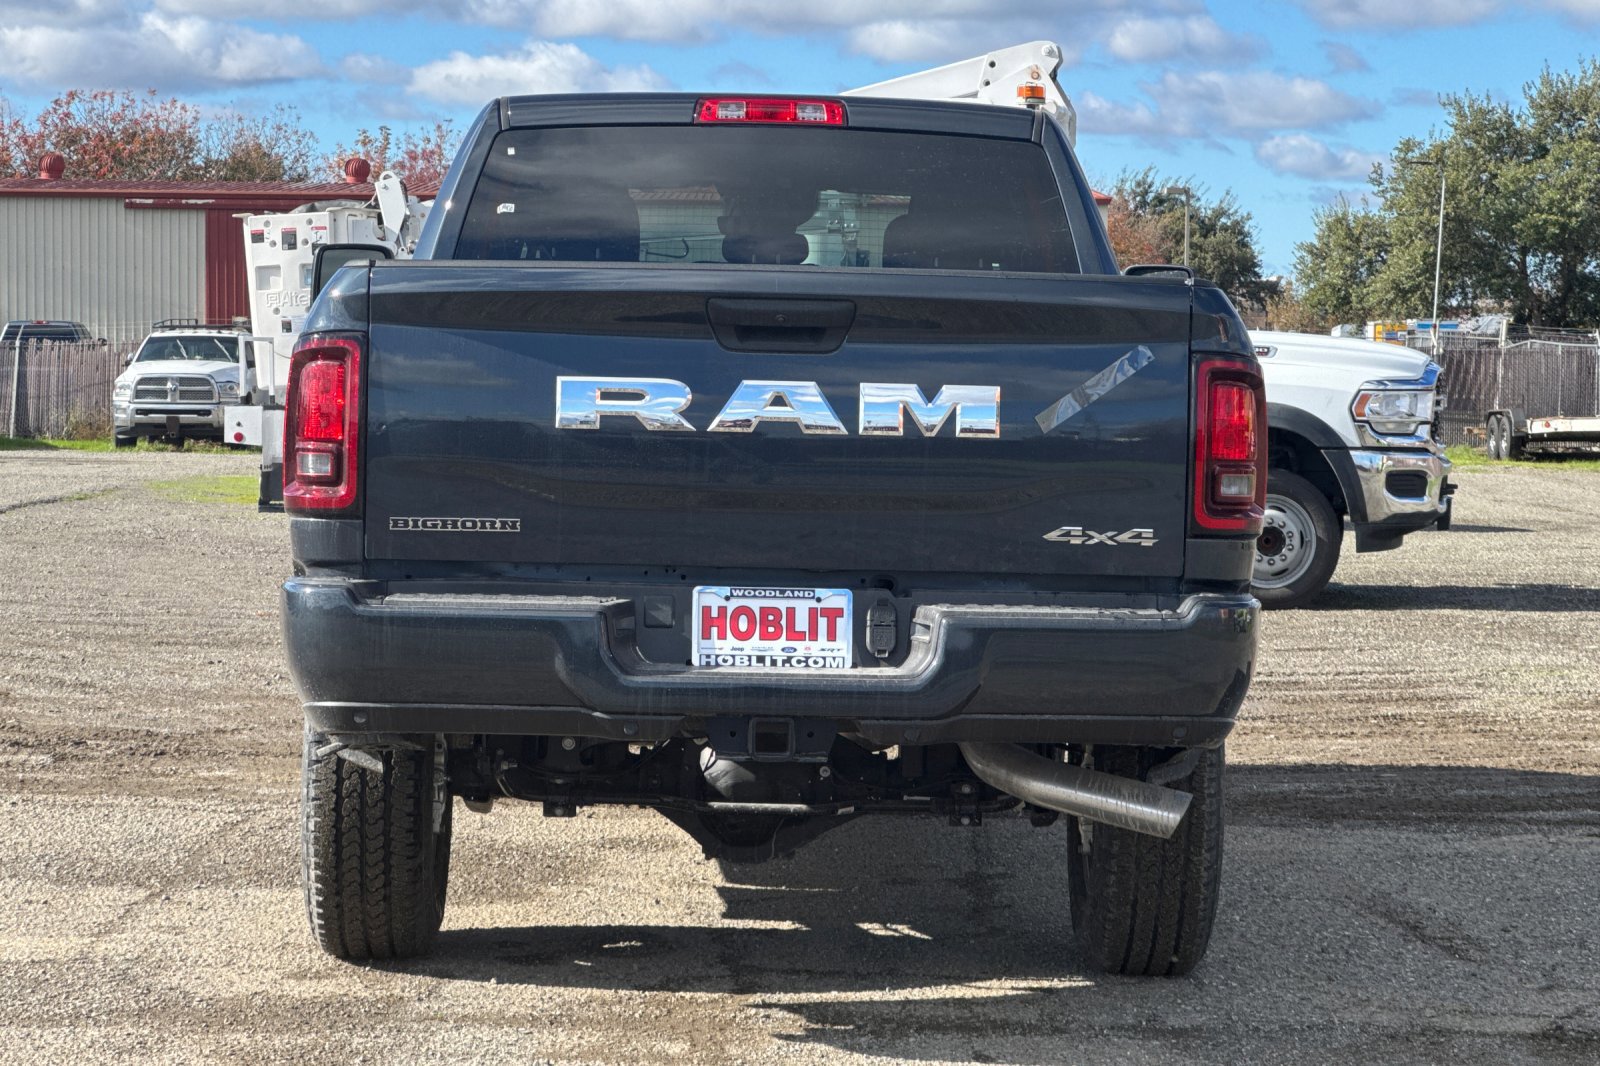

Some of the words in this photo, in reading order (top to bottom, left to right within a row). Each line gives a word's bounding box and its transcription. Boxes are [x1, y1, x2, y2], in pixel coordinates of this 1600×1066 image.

[281, 291, 310, 307] Alte
[555, 375, 1001, 439] RAM
[389, 516, 521, 532] BIGHORN
[731, 589, 815, 598] WOODLAND
[701, 605, 844, 642] HOBLIT
[700, 655, 844, 668] HOBLIT.COM
